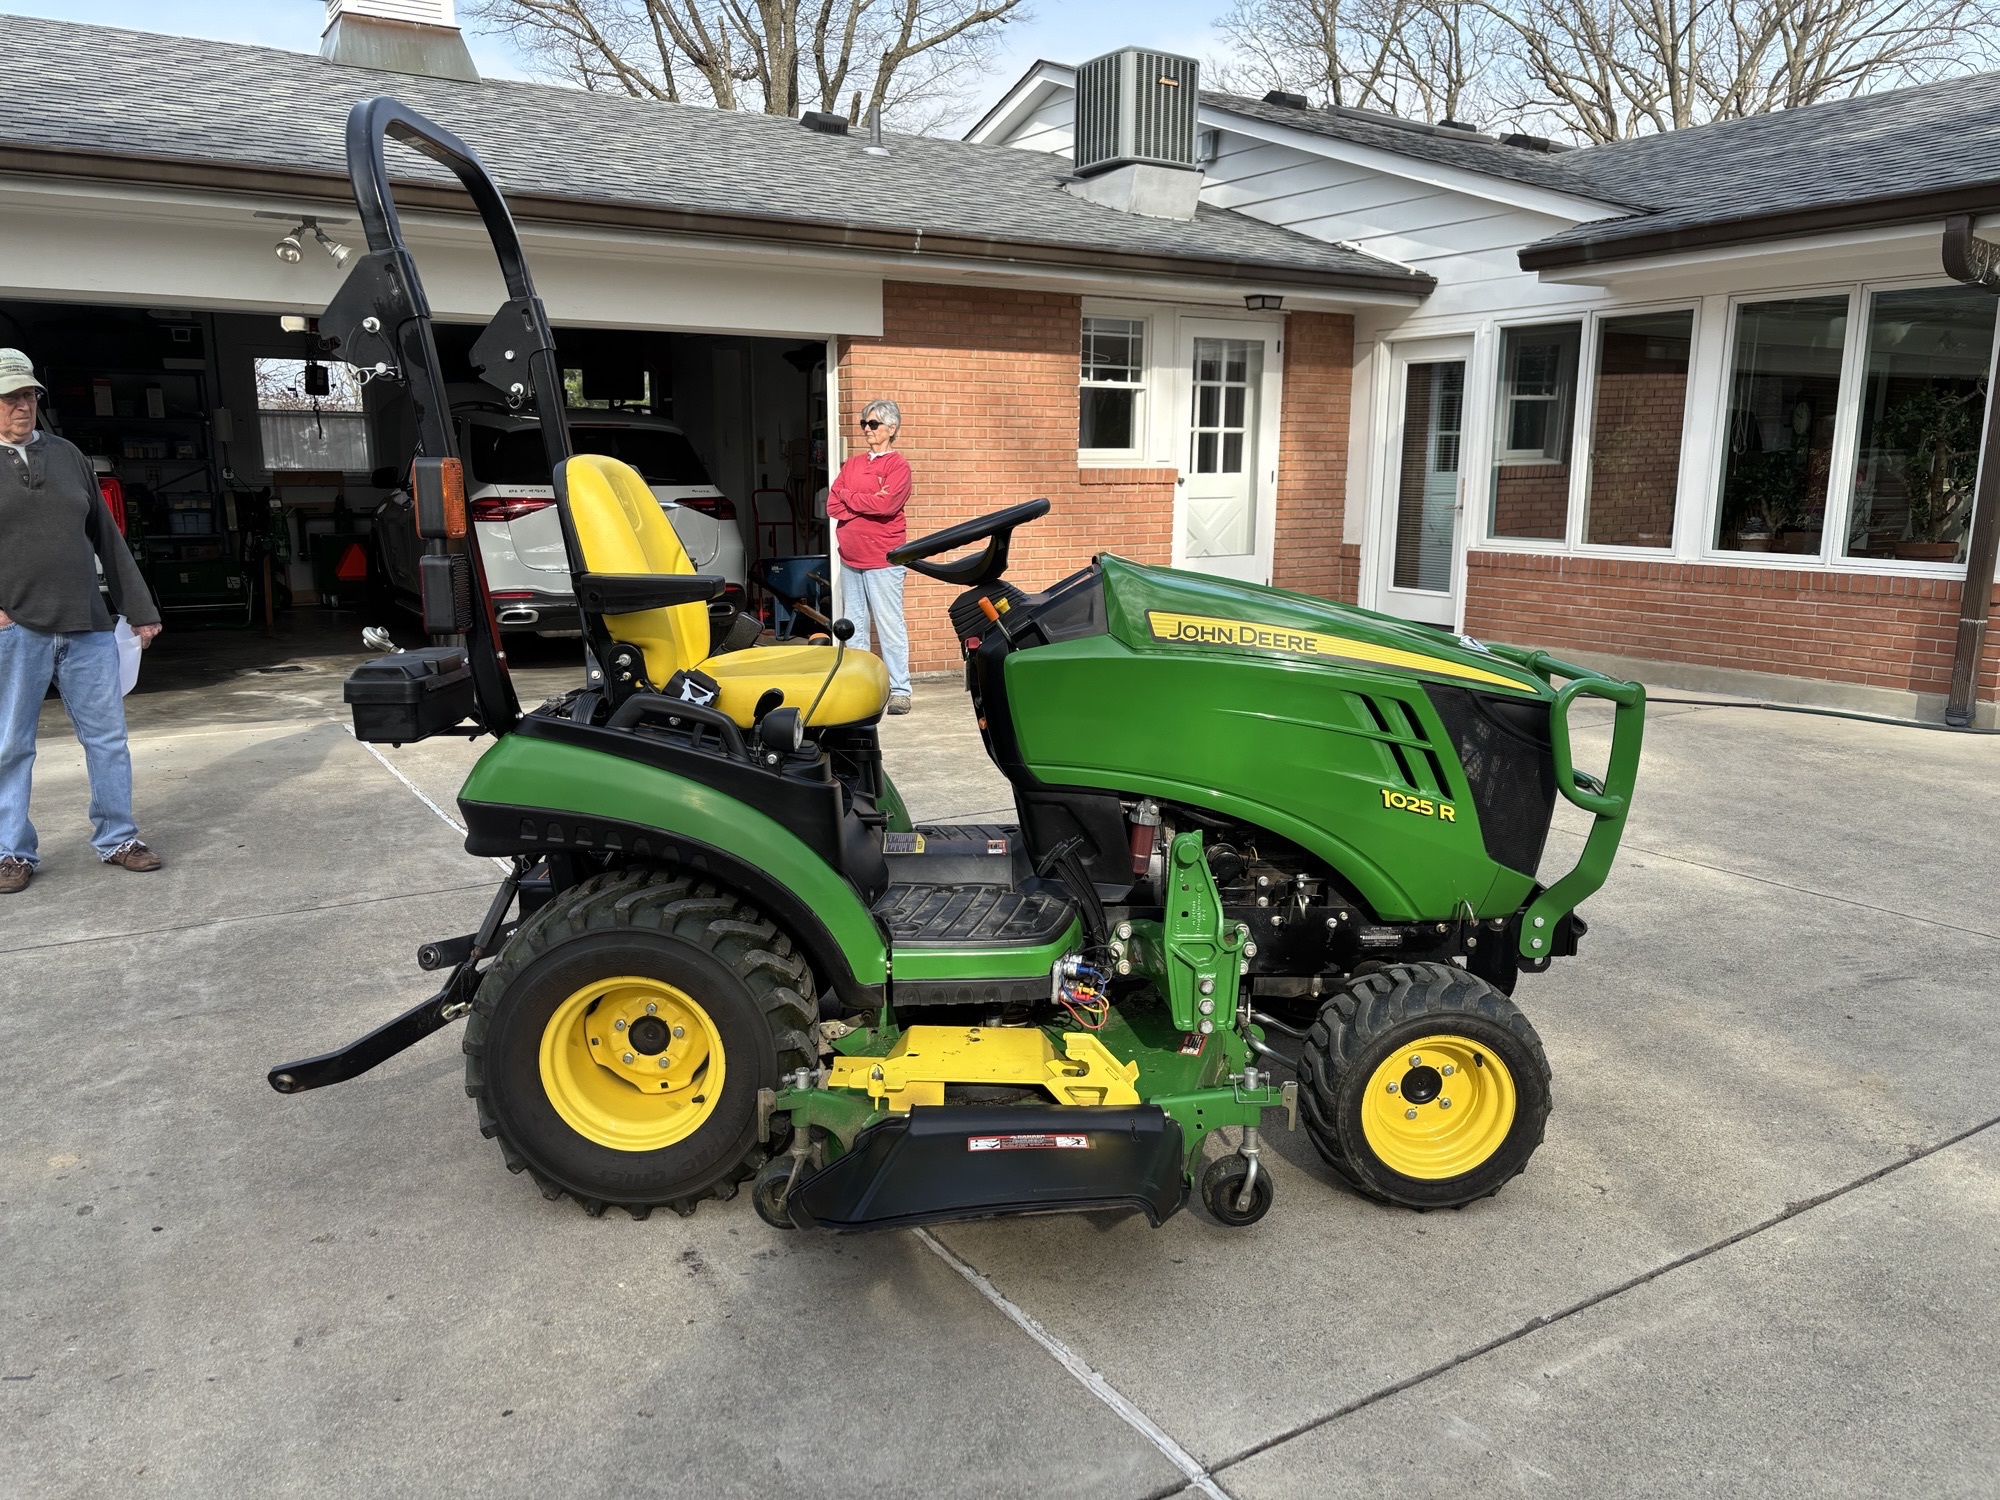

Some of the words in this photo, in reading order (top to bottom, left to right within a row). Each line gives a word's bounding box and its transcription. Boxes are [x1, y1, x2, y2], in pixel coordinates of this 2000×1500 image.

[1168, 621, 1233, 642] JOHN
[1239, 626, 1318, 652] DEERE
[1380, 788, 1434, 816] 1025
[1438, 803, 1456, 823] R
